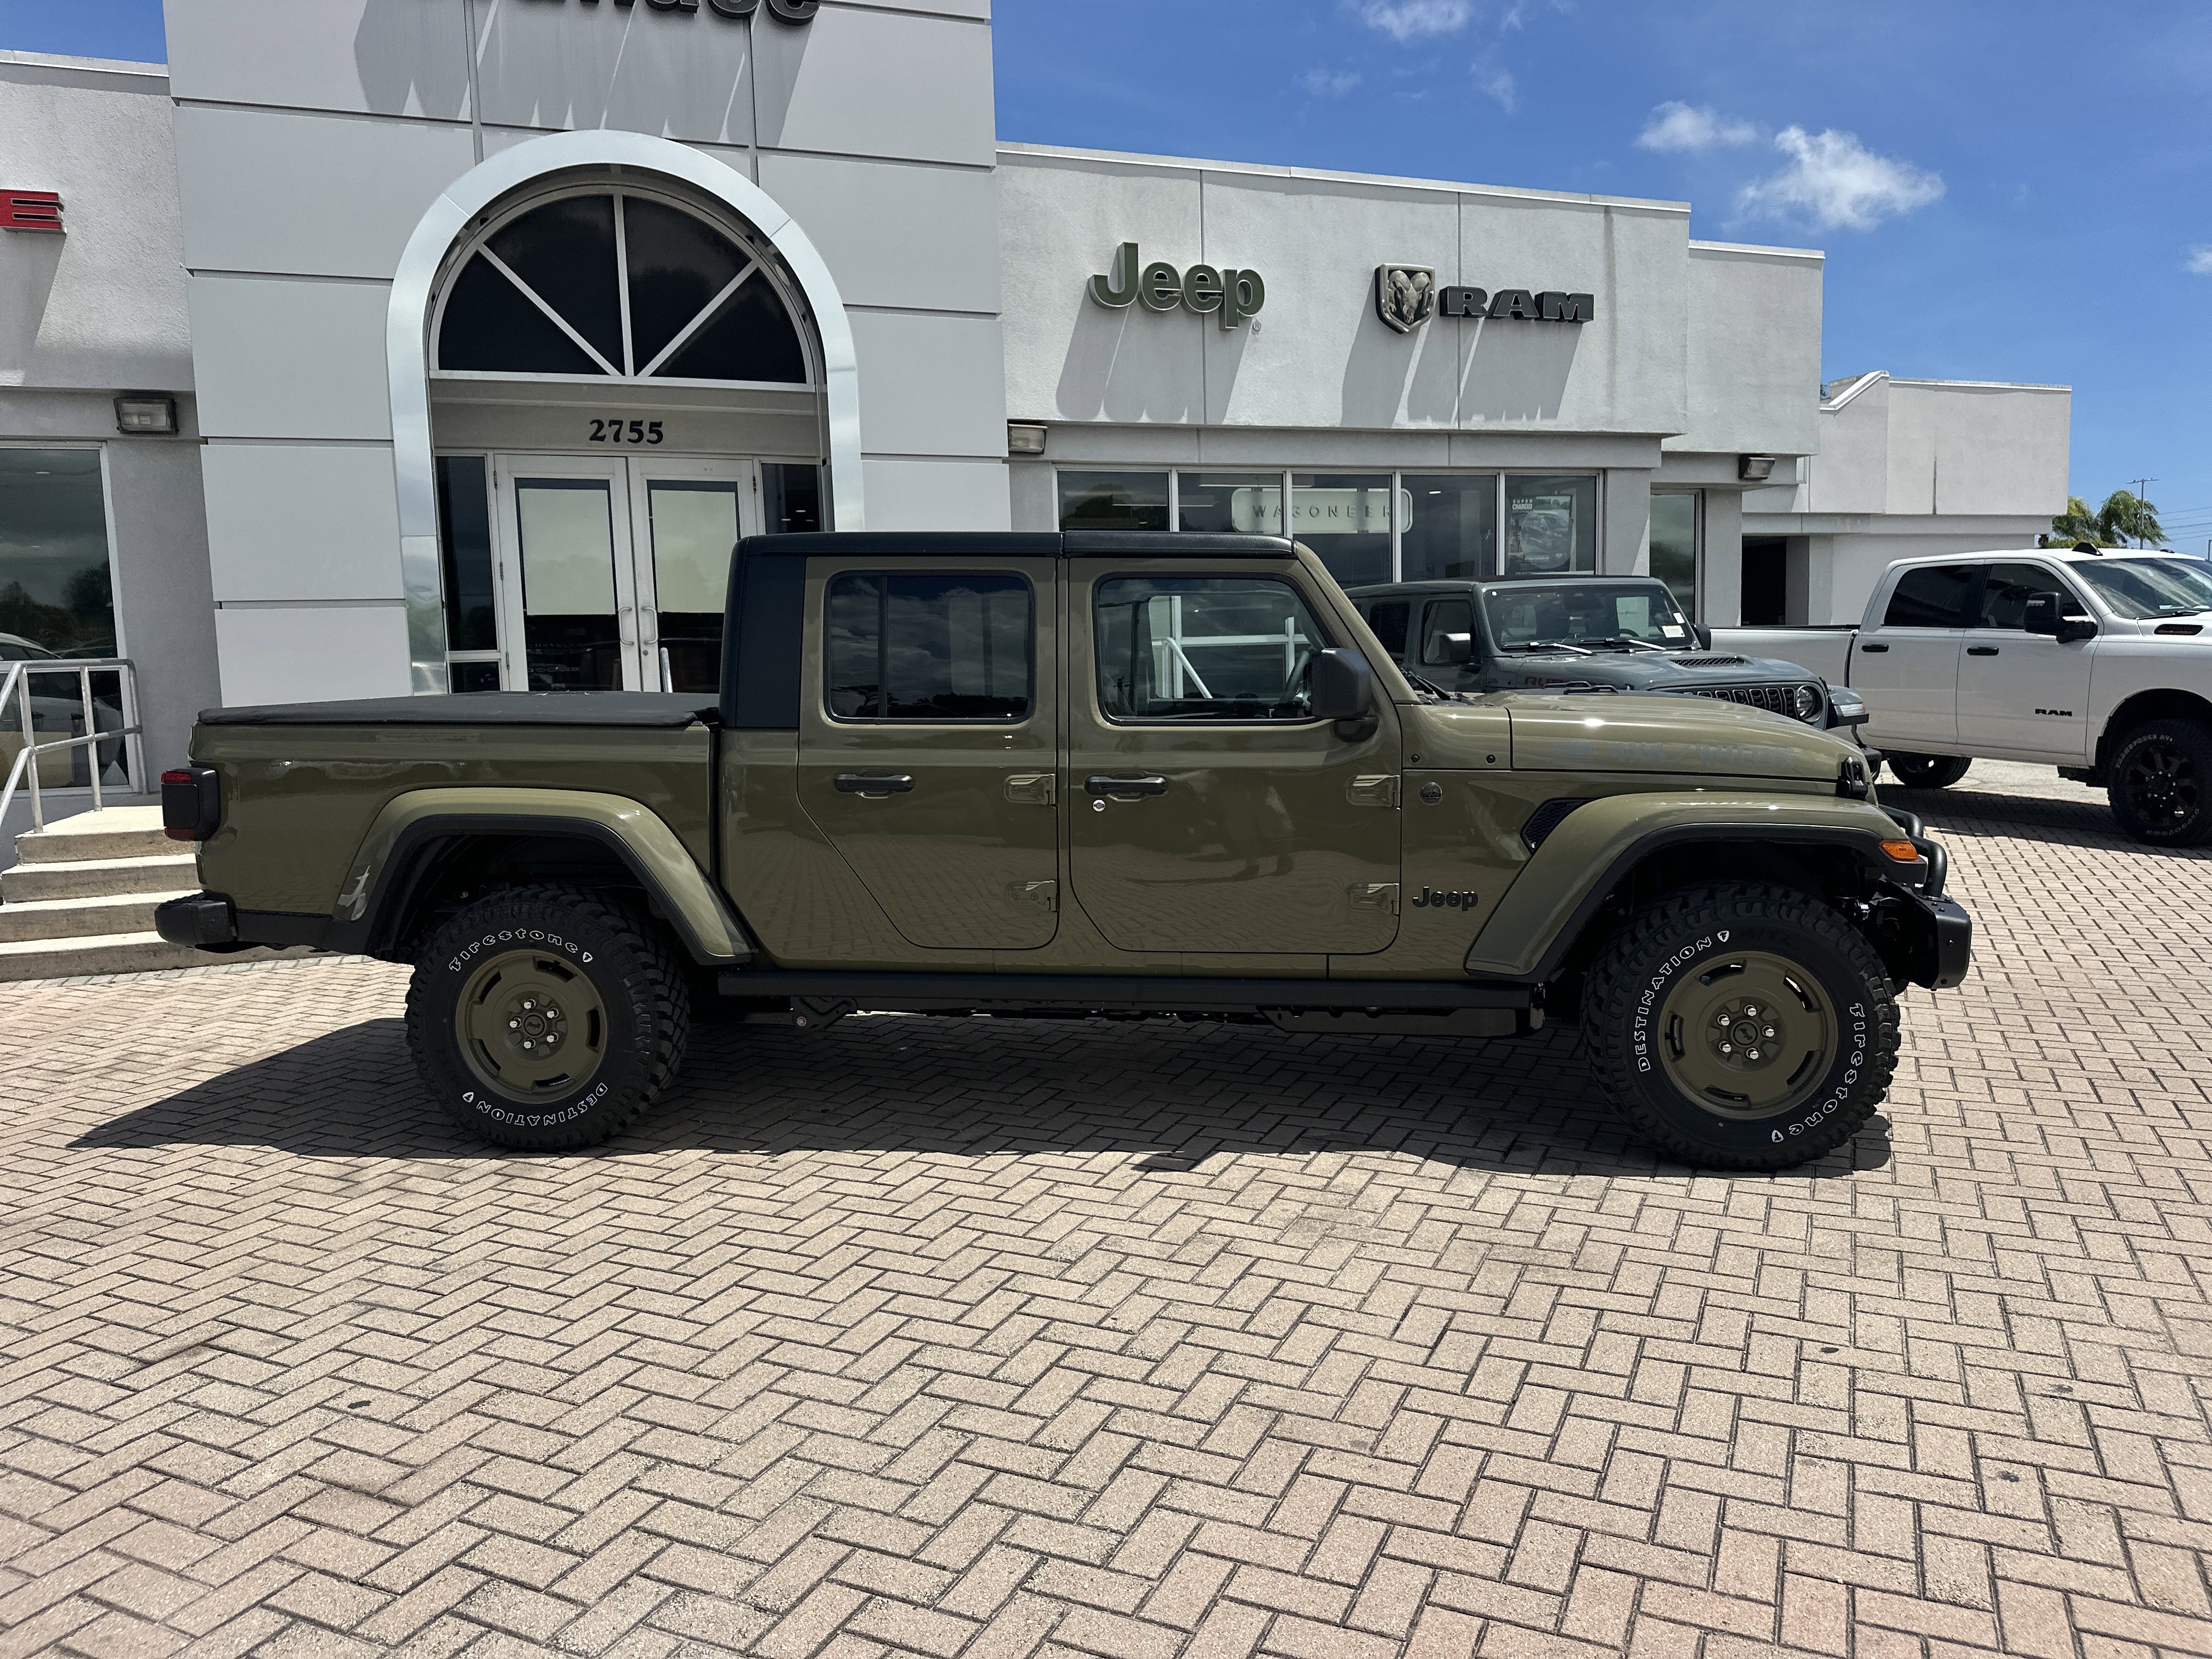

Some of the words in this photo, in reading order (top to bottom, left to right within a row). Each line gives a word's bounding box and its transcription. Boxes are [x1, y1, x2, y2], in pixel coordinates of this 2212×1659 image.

[1088, 242, 1265, 331] Jeep
[1440, 286, 1594, 323] RAM
[589, 419, 664, 444] 2755
[2035, 708, 2072, 716] RAM
[1412, 885, 1479, 912] Jeep
[1634, 936, 1712, 1072] DESTINATION
[476, 1082, 608, 1126] DESTINATION
